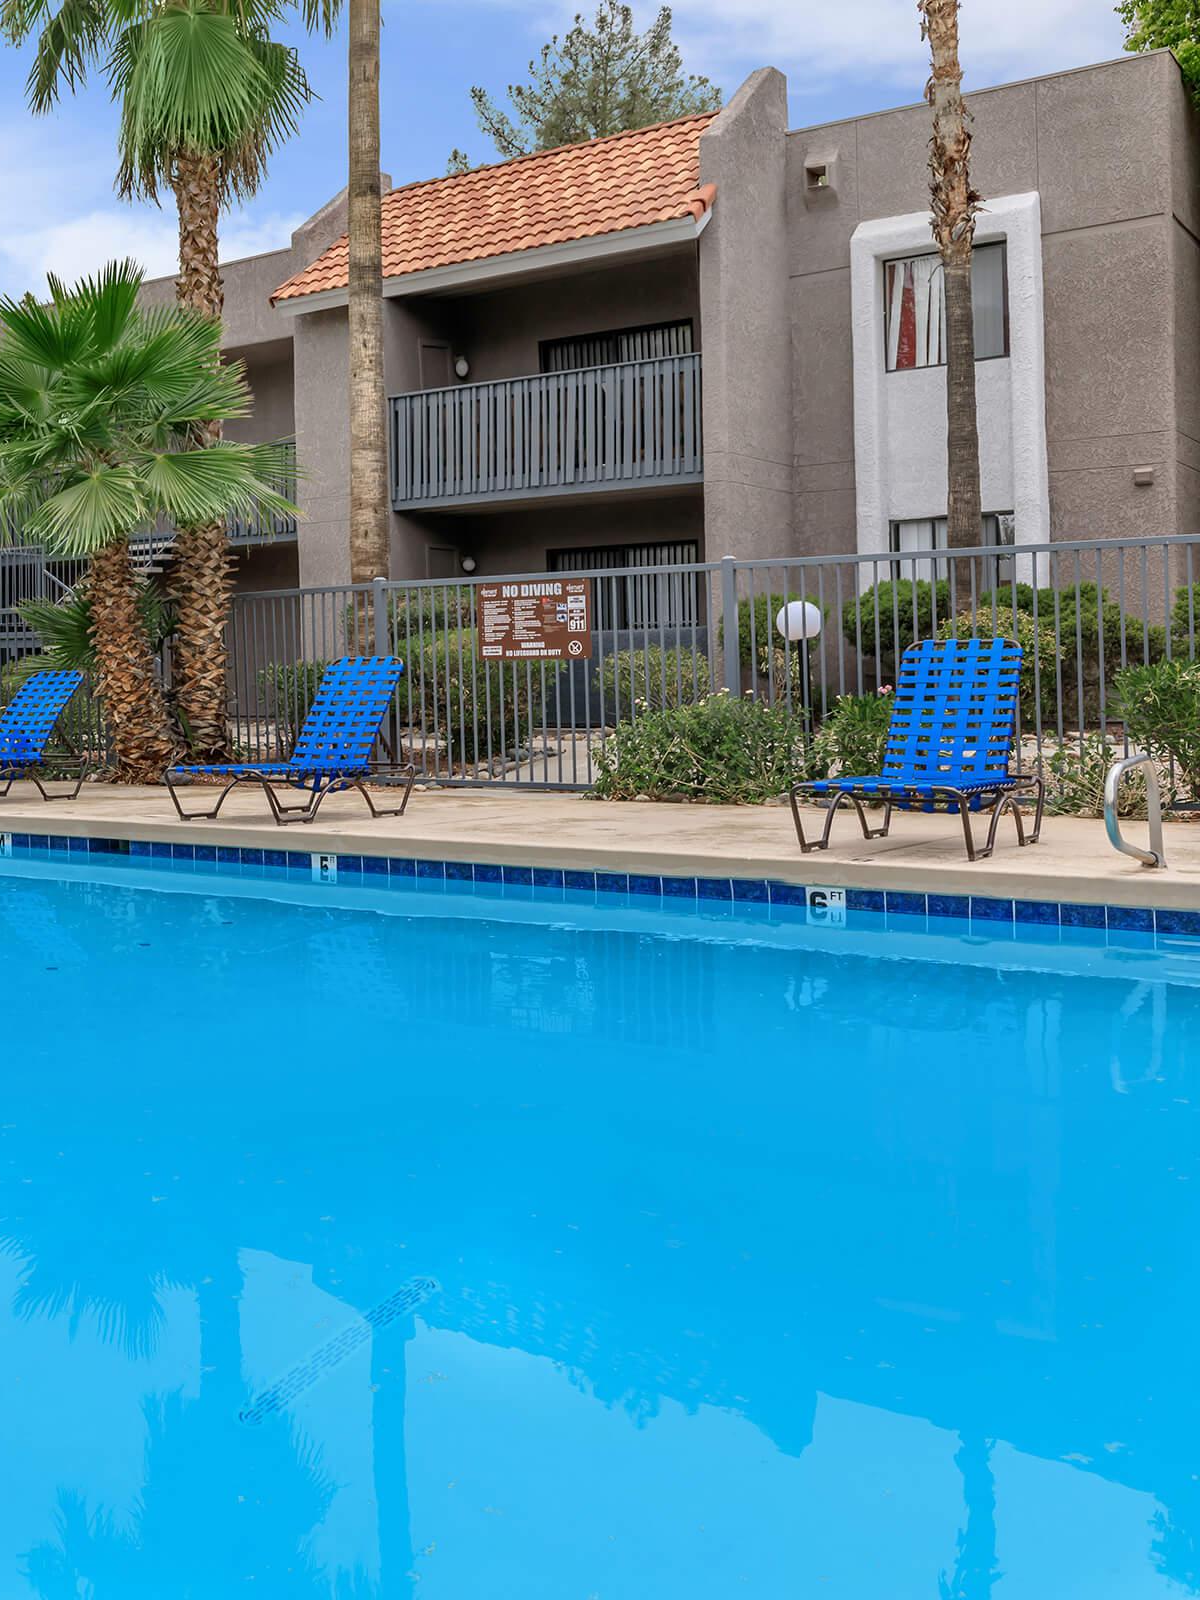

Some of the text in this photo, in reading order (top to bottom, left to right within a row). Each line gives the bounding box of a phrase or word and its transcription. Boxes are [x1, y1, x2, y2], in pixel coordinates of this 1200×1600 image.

[503, 583, 562, 598] NO DIVING
[570, 620, 584, 630] 911
[830, 891, 843, 901] FT
